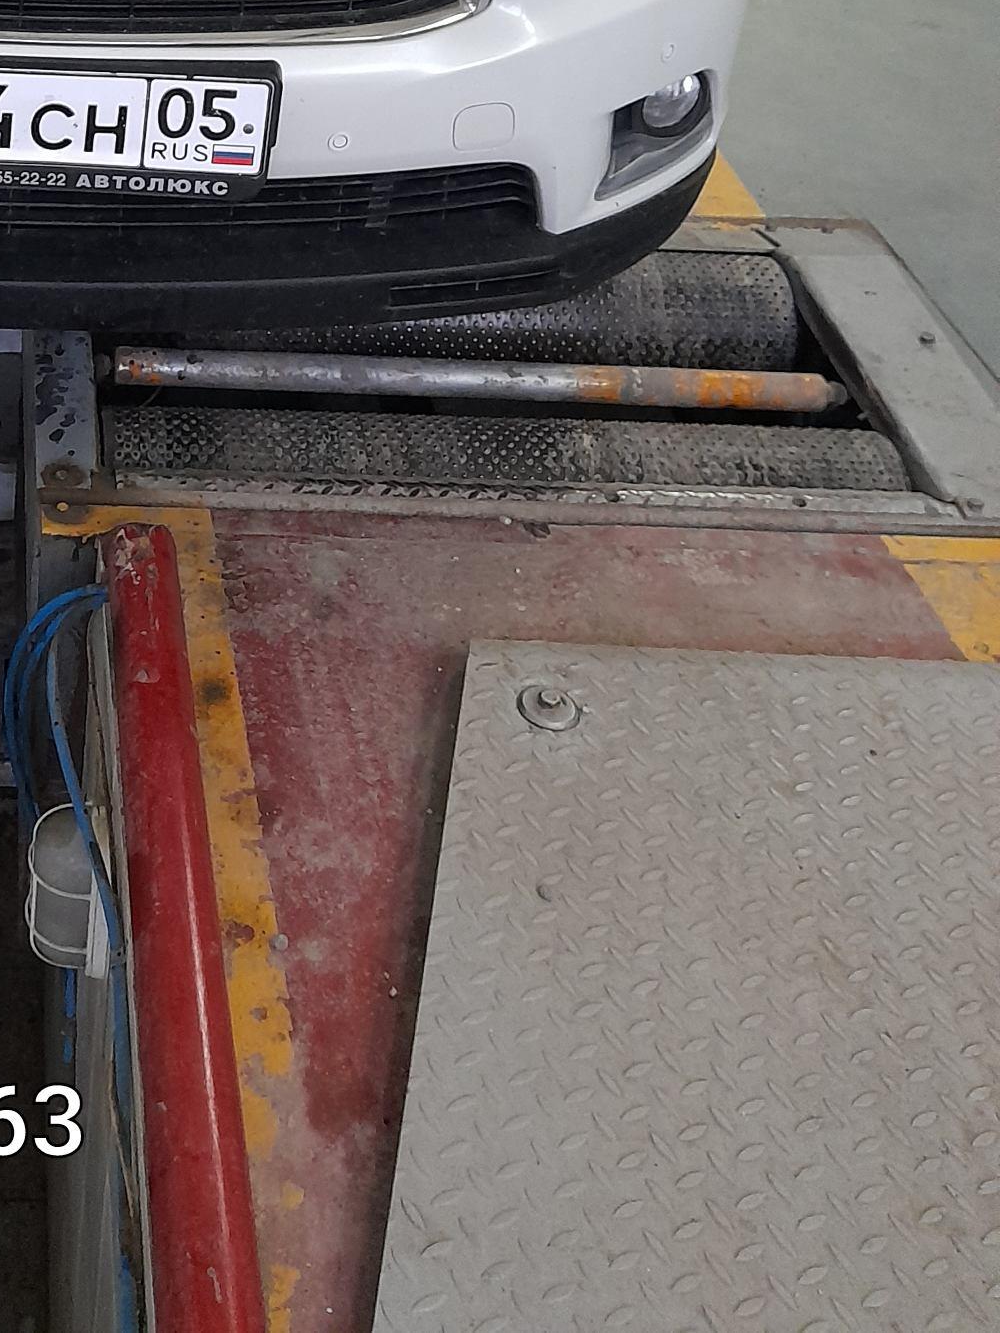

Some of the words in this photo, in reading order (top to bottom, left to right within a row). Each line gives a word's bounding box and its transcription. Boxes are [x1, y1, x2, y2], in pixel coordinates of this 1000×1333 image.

[156, 87, 239, 141] 05
[150, 142, 209, 162] RUS
[75, 174, 229, 196] АВТОЛЮКС
